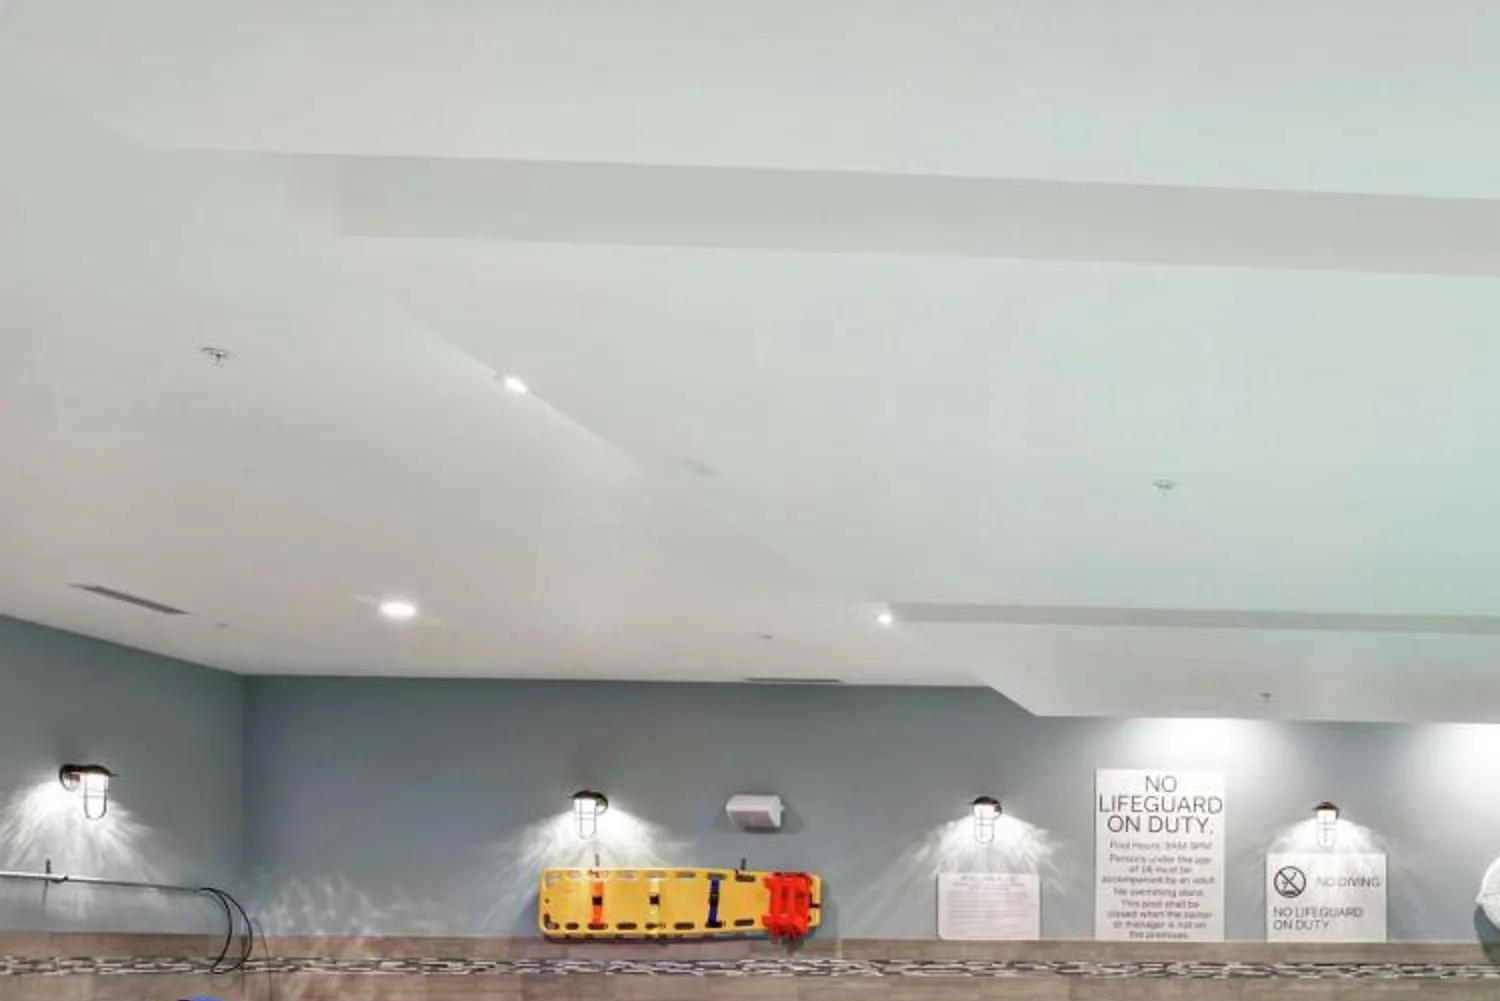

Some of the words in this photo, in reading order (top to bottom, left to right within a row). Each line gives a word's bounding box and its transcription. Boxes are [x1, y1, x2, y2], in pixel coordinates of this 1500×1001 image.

[1145, 775, 1178, 793] NO
[1099, 795, 1223, 814] LIFEGUARD
[1107, 815, 1141, 833] ON
[1149, 815, 1214, 835] DUTY.
[1272, 906, 1294, 918] NO
[1295, 906, 1364, 918] LIFEGUARD
[1272, 919, 1292, 931] ON
[1295, 919, 1330, 931] DUTY
